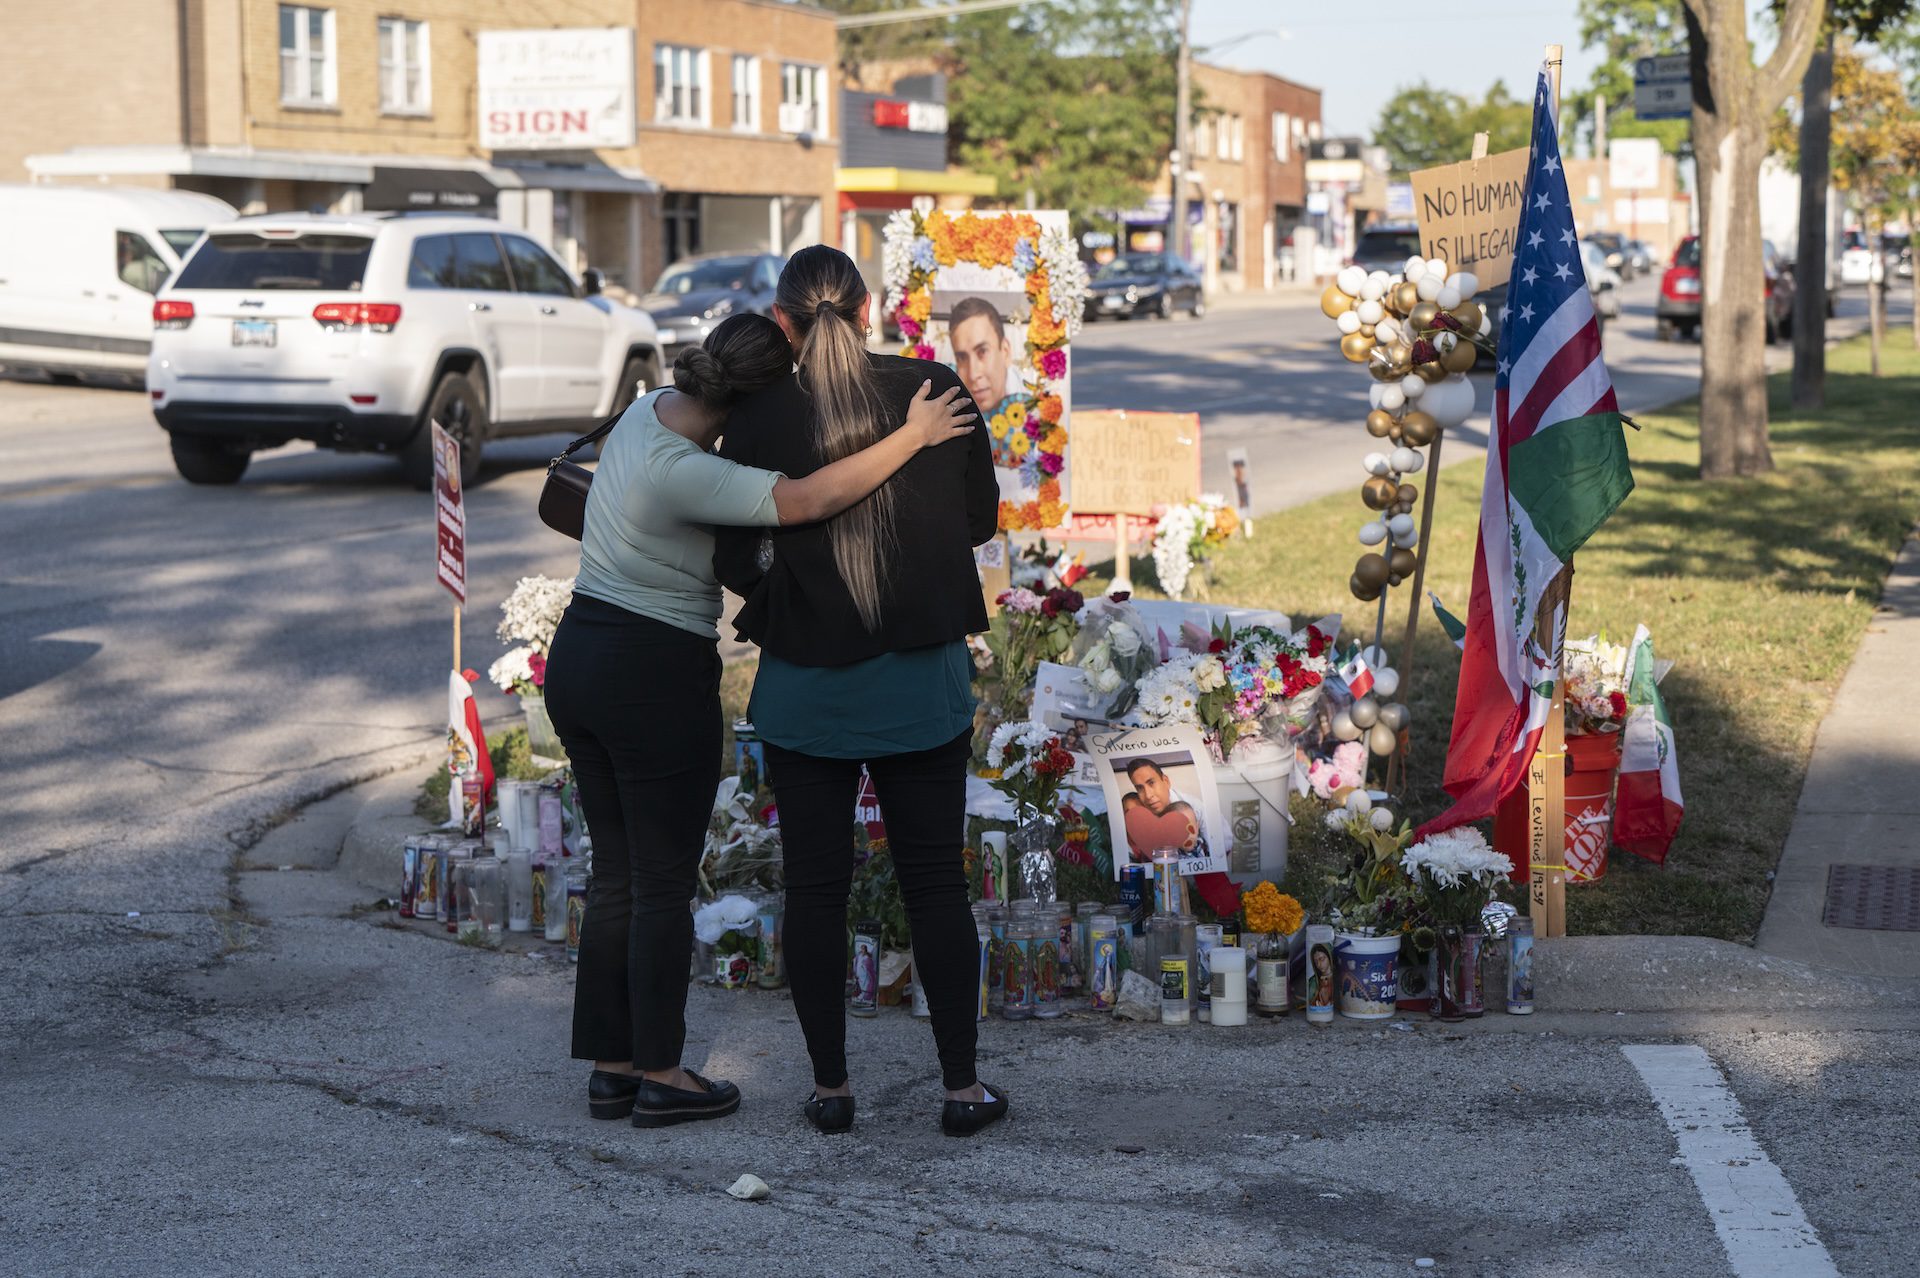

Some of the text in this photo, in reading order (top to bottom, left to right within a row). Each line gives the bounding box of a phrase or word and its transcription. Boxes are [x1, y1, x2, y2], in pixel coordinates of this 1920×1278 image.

[488, 110, 588, 133] SIGN
[1424, 174, 1527, 223] NO HUMAN
[1429, 238, 1448, 263] IS
[1092, 734, 1180, 755] Silverio was
[856, 804, 880, 822] gal
[1532, 797, 1545, 862] Leviticus
[1371, 971, 1387, 983] Six
